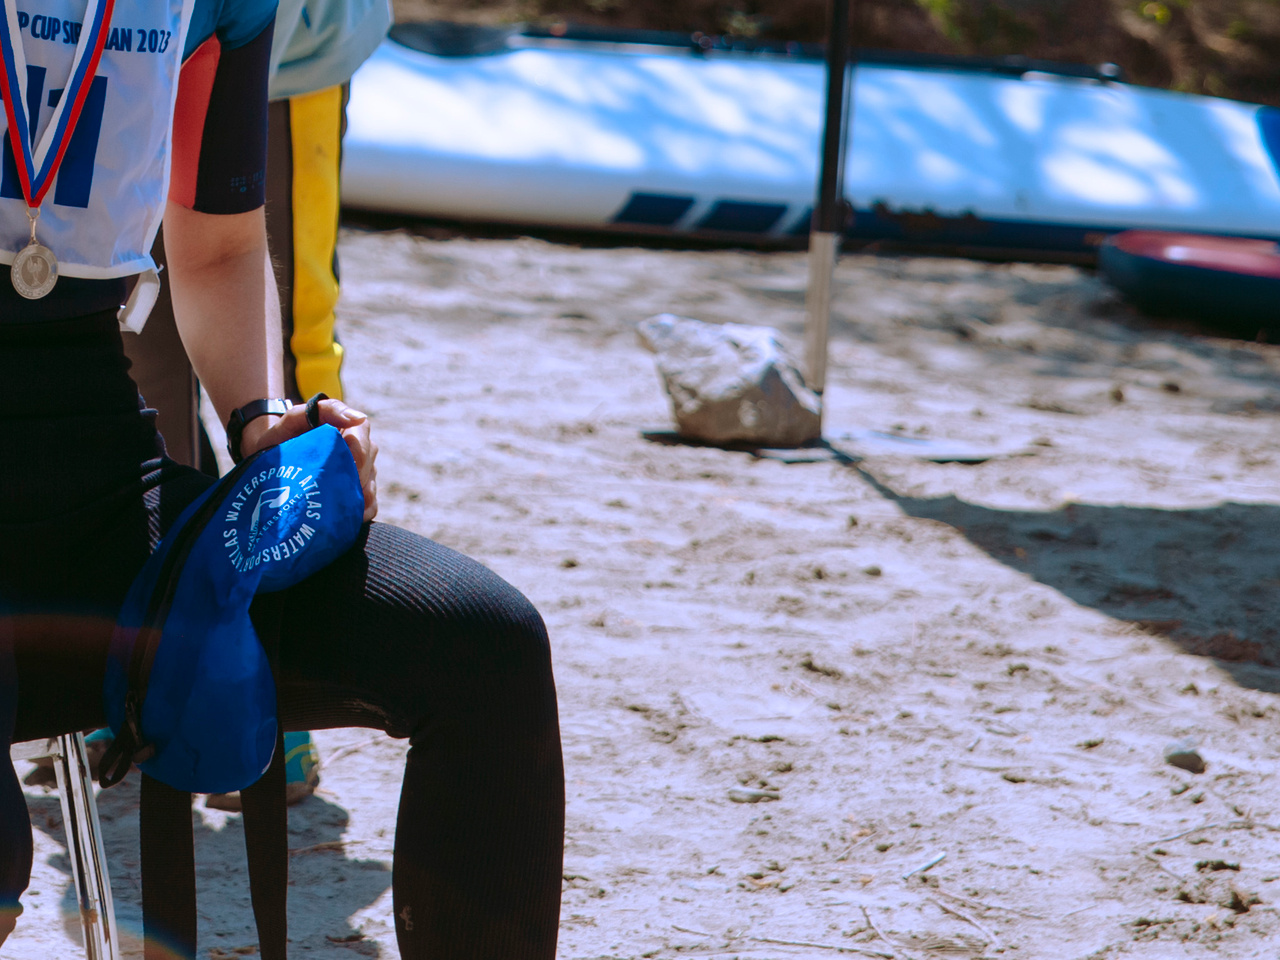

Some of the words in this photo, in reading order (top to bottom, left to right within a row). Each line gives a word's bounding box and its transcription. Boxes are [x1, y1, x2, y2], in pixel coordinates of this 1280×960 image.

[31, 14, 61, 41] CUP
[62, 20, 132, 52] SIBAN
[137, 28, 172, 53] 2023
[225, 465, 303, 522] WATERSPORT
[298, 474, 322, 520] ATLAS
